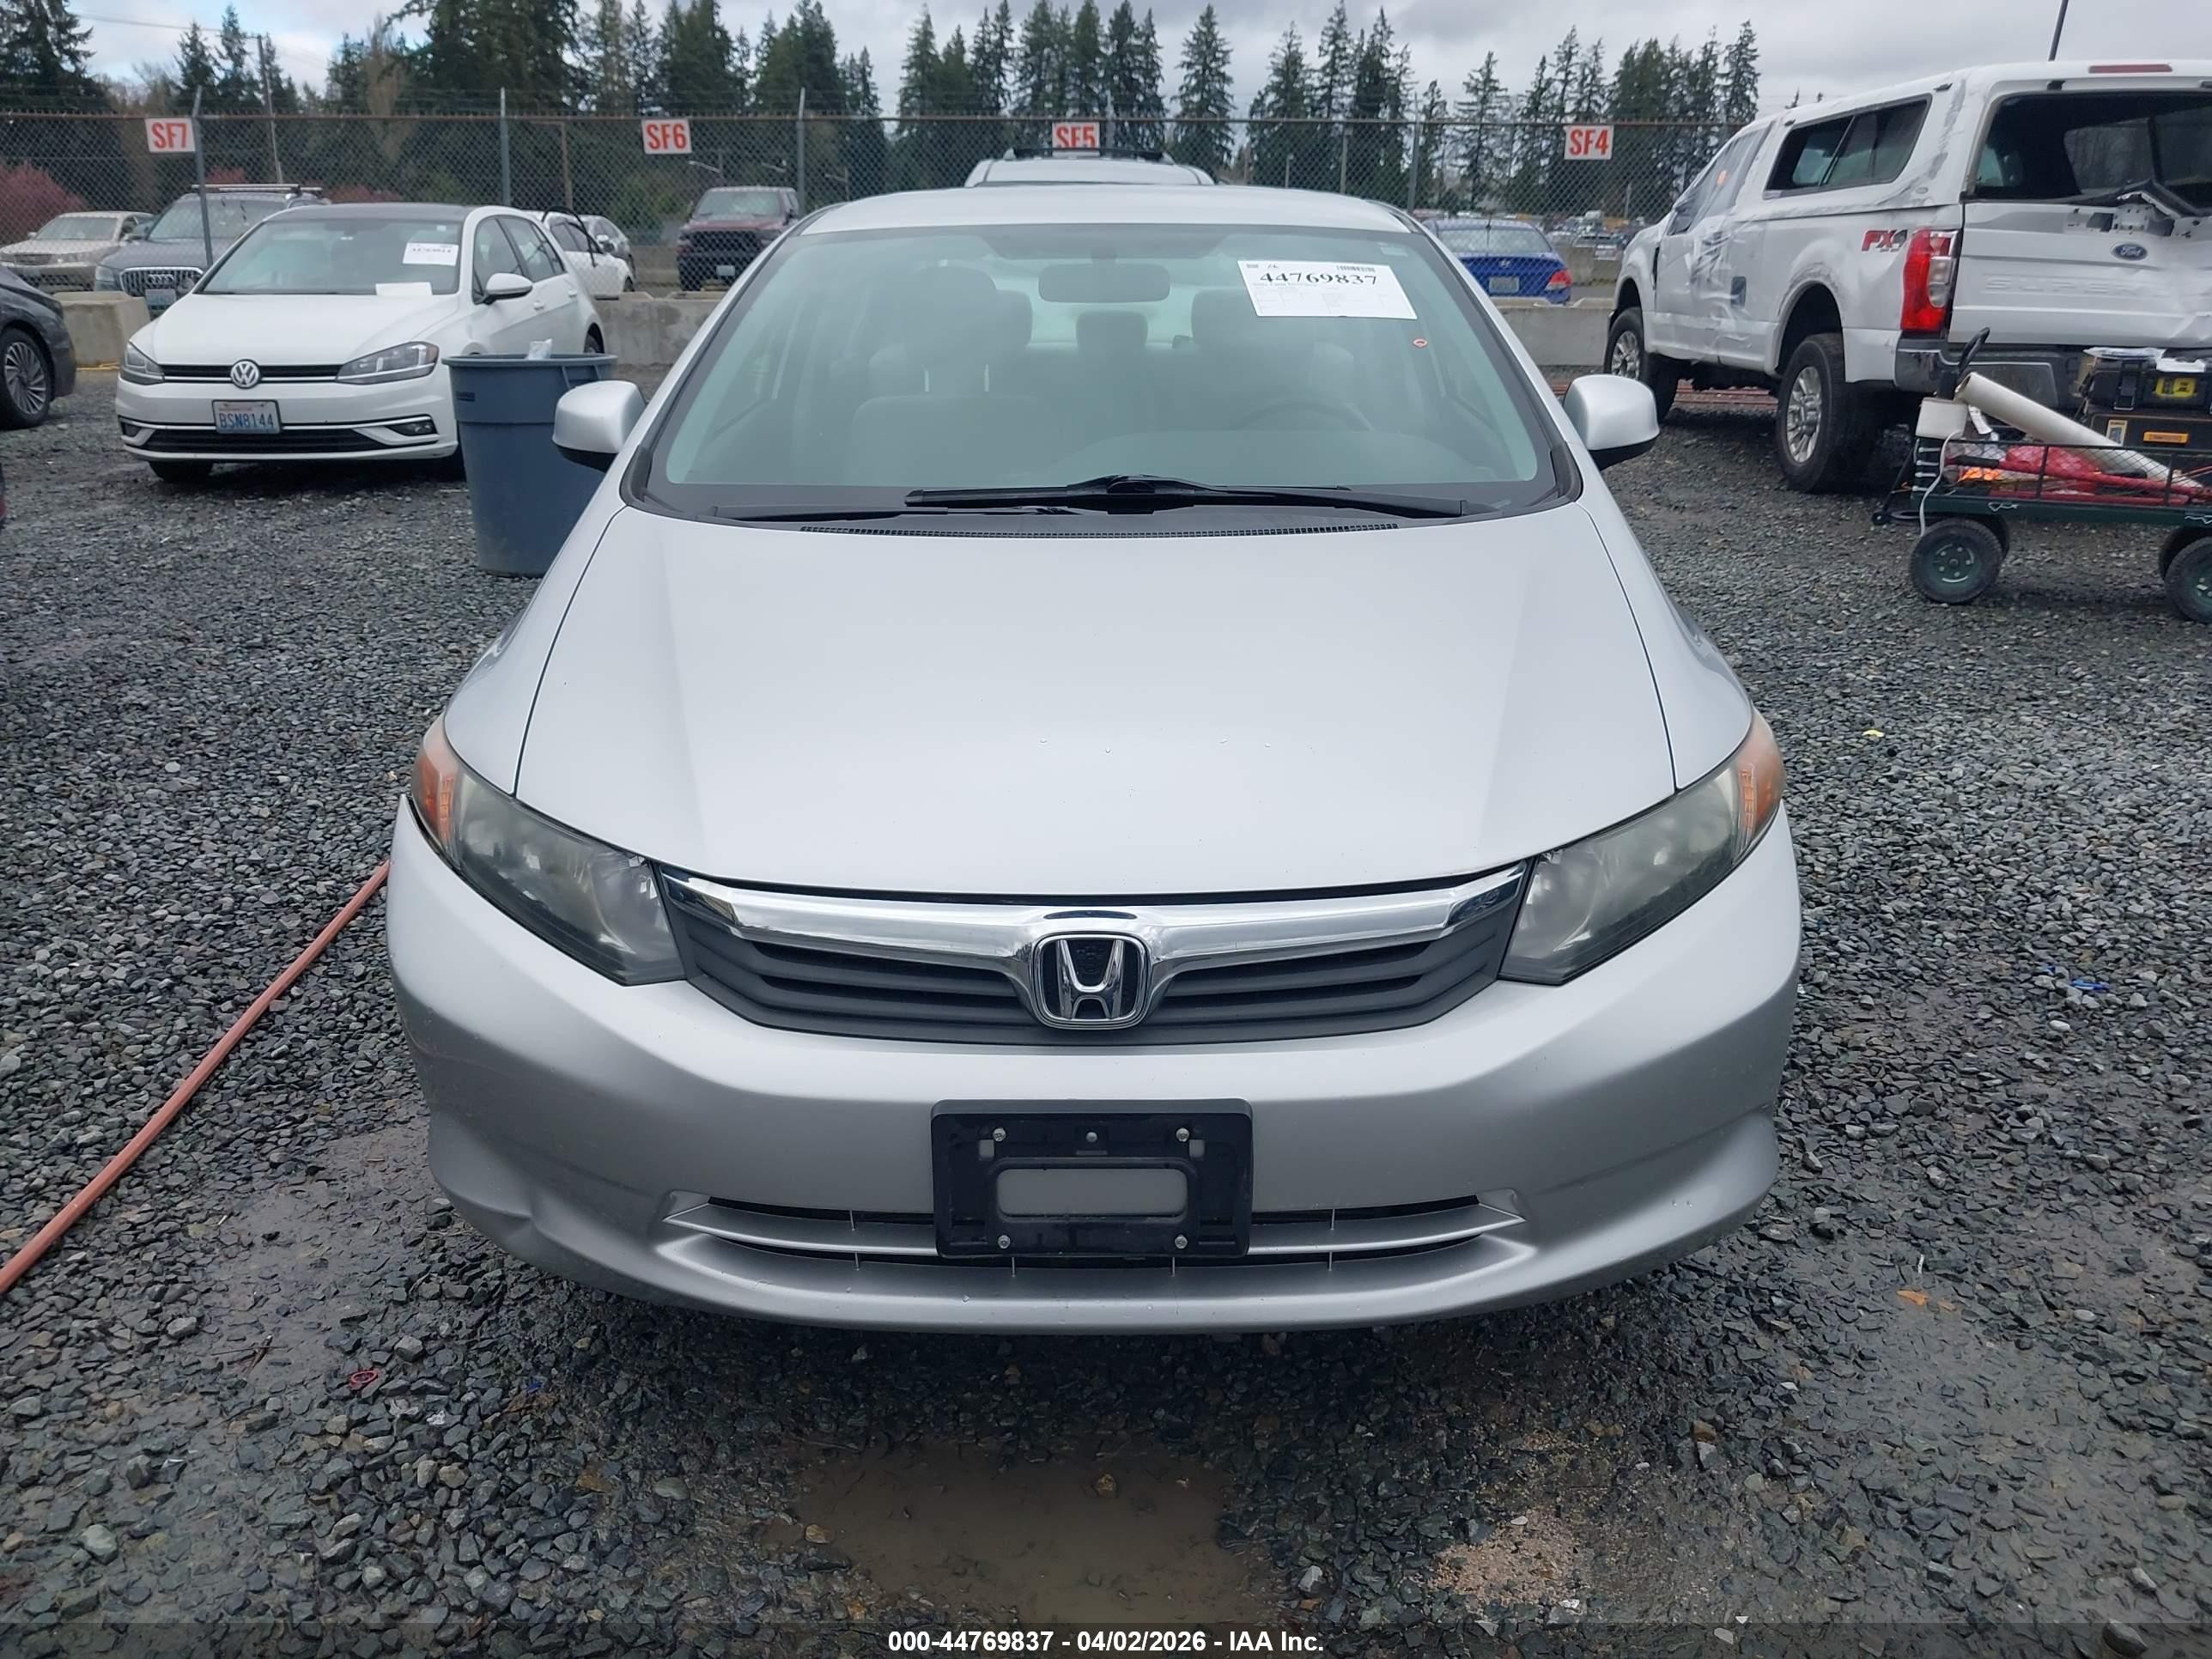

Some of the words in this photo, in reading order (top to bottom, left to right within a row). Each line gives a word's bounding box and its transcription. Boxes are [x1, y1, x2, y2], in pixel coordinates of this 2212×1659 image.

[151, 122, 187, 149] SF7
[646, 124, 687, 149] SF6
[1056, 125, 1097, 149] SF5
[1569, 129, 1609, 156] SF4
[1862, 229, 1908, 252] FX4
[2119, 246, 2143, 257] Ford
[1259, 271, 1377, 286] 44769837
[218, 412, 275, 428] BSN8144
